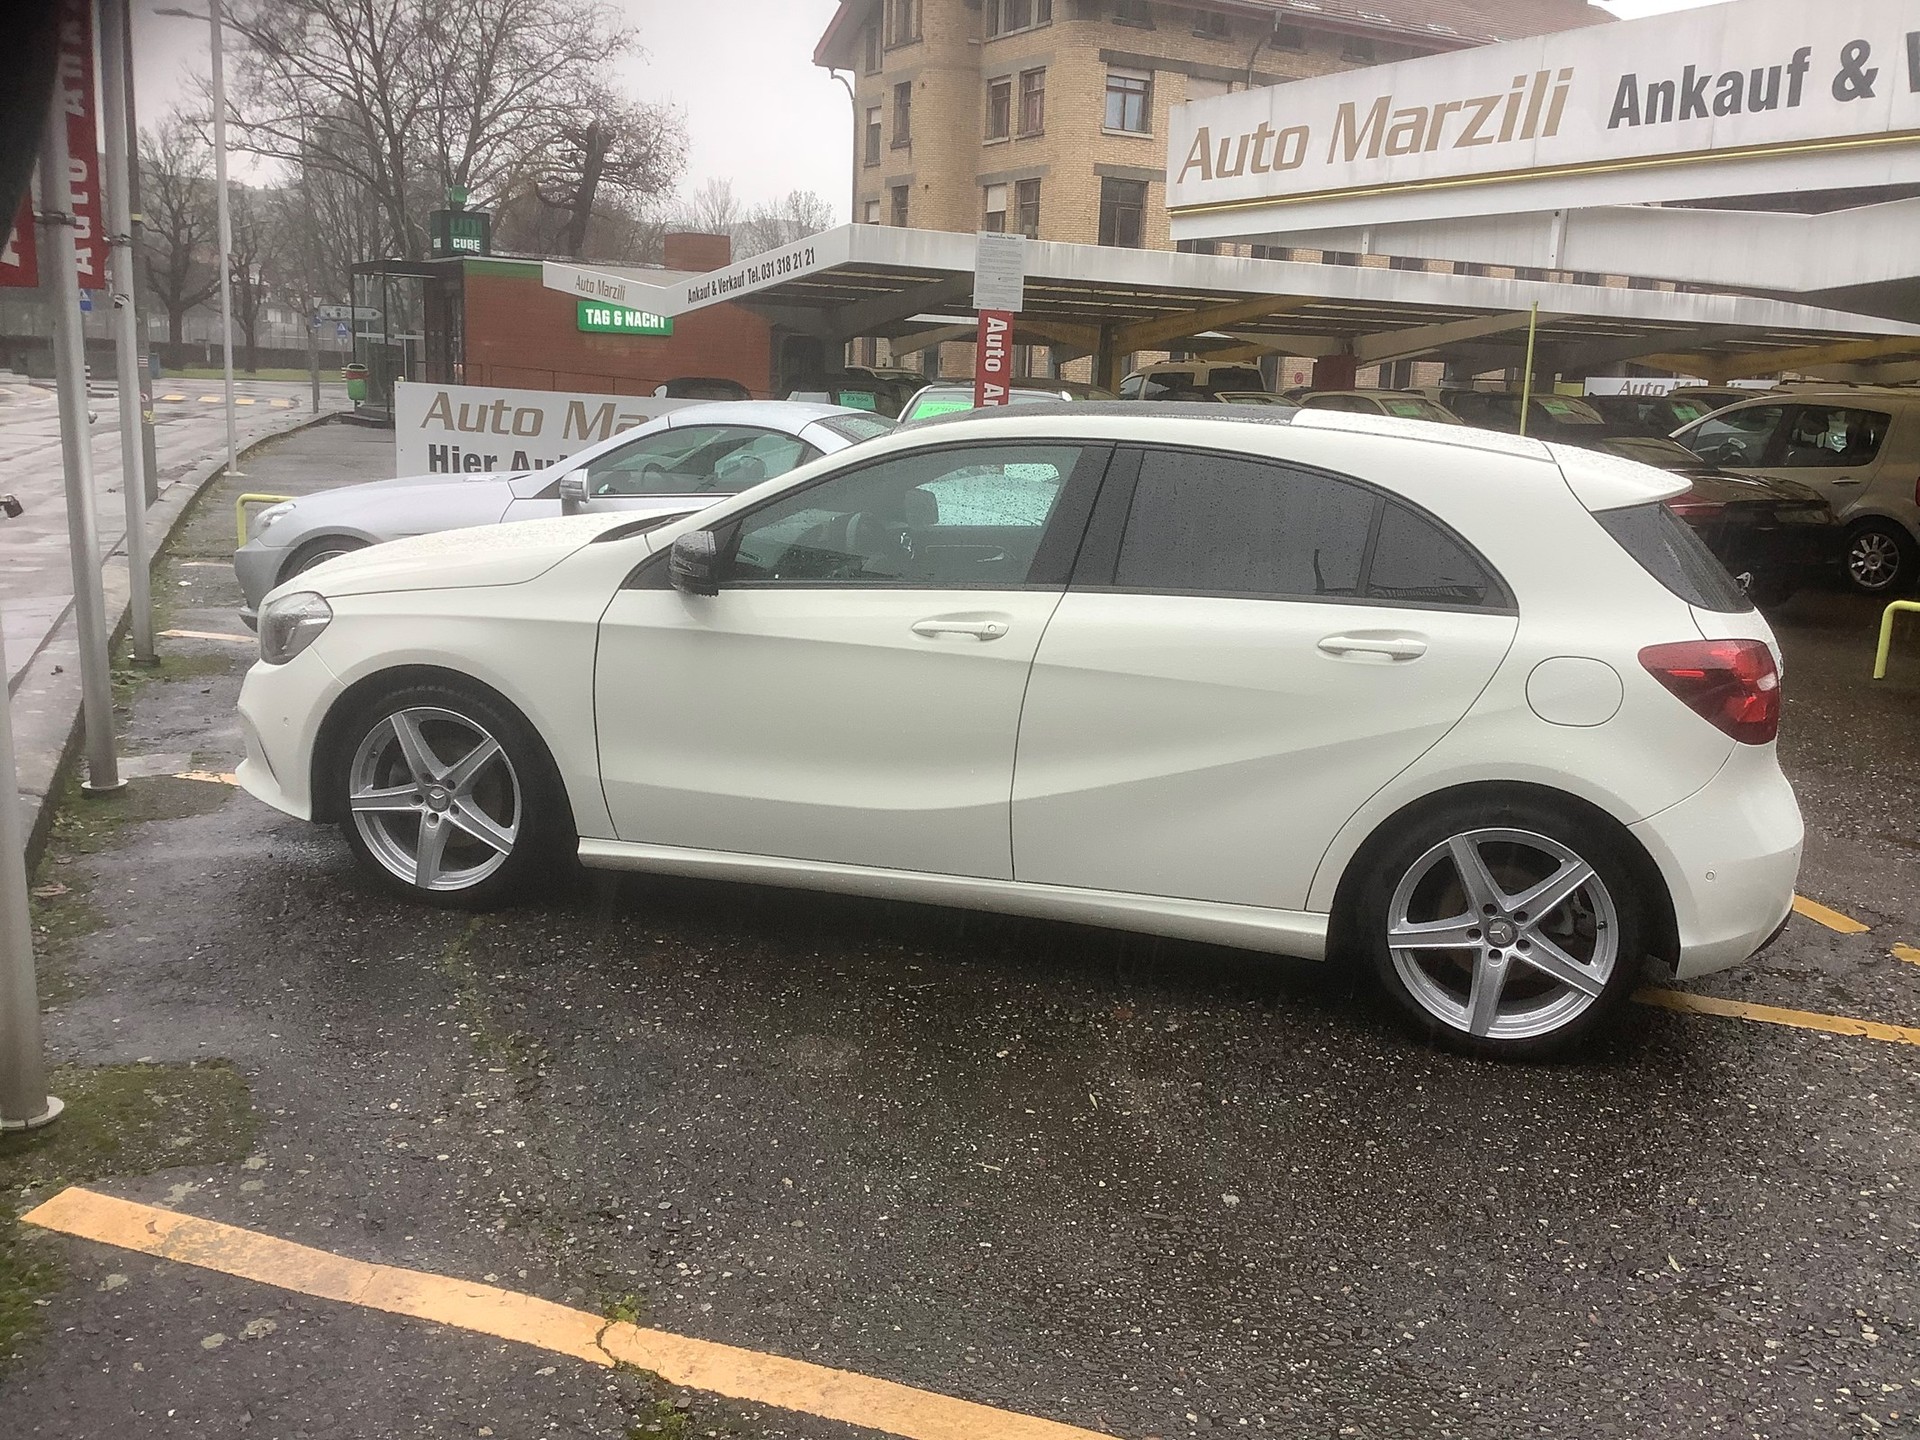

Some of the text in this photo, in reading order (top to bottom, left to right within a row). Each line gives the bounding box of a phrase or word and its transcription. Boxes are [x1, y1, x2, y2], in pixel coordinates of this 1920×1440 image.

[1177, 120, 1310, 184] Auto
[1326, 67, 1574, 165] Marzili
[1607, 46, 1812, 129] Ankauf
[1831, 39, 1879, 102] &
[453, 238, 480, 250] CUBE
[575, 274, 626, 302] Auto Marzili
[687, 246, 815, 304] Ankauf & Verkauf Tel. 031 318 21 21
[586, 308, 610, 325] TAG
[614, 310, 622, 326] &
[984, 317, 1008, 372] Auto
[1619, 380, 1666, 396] Auto
[420, 391, 544, 437] Auto
[428, 443, 498, 473] Hier
